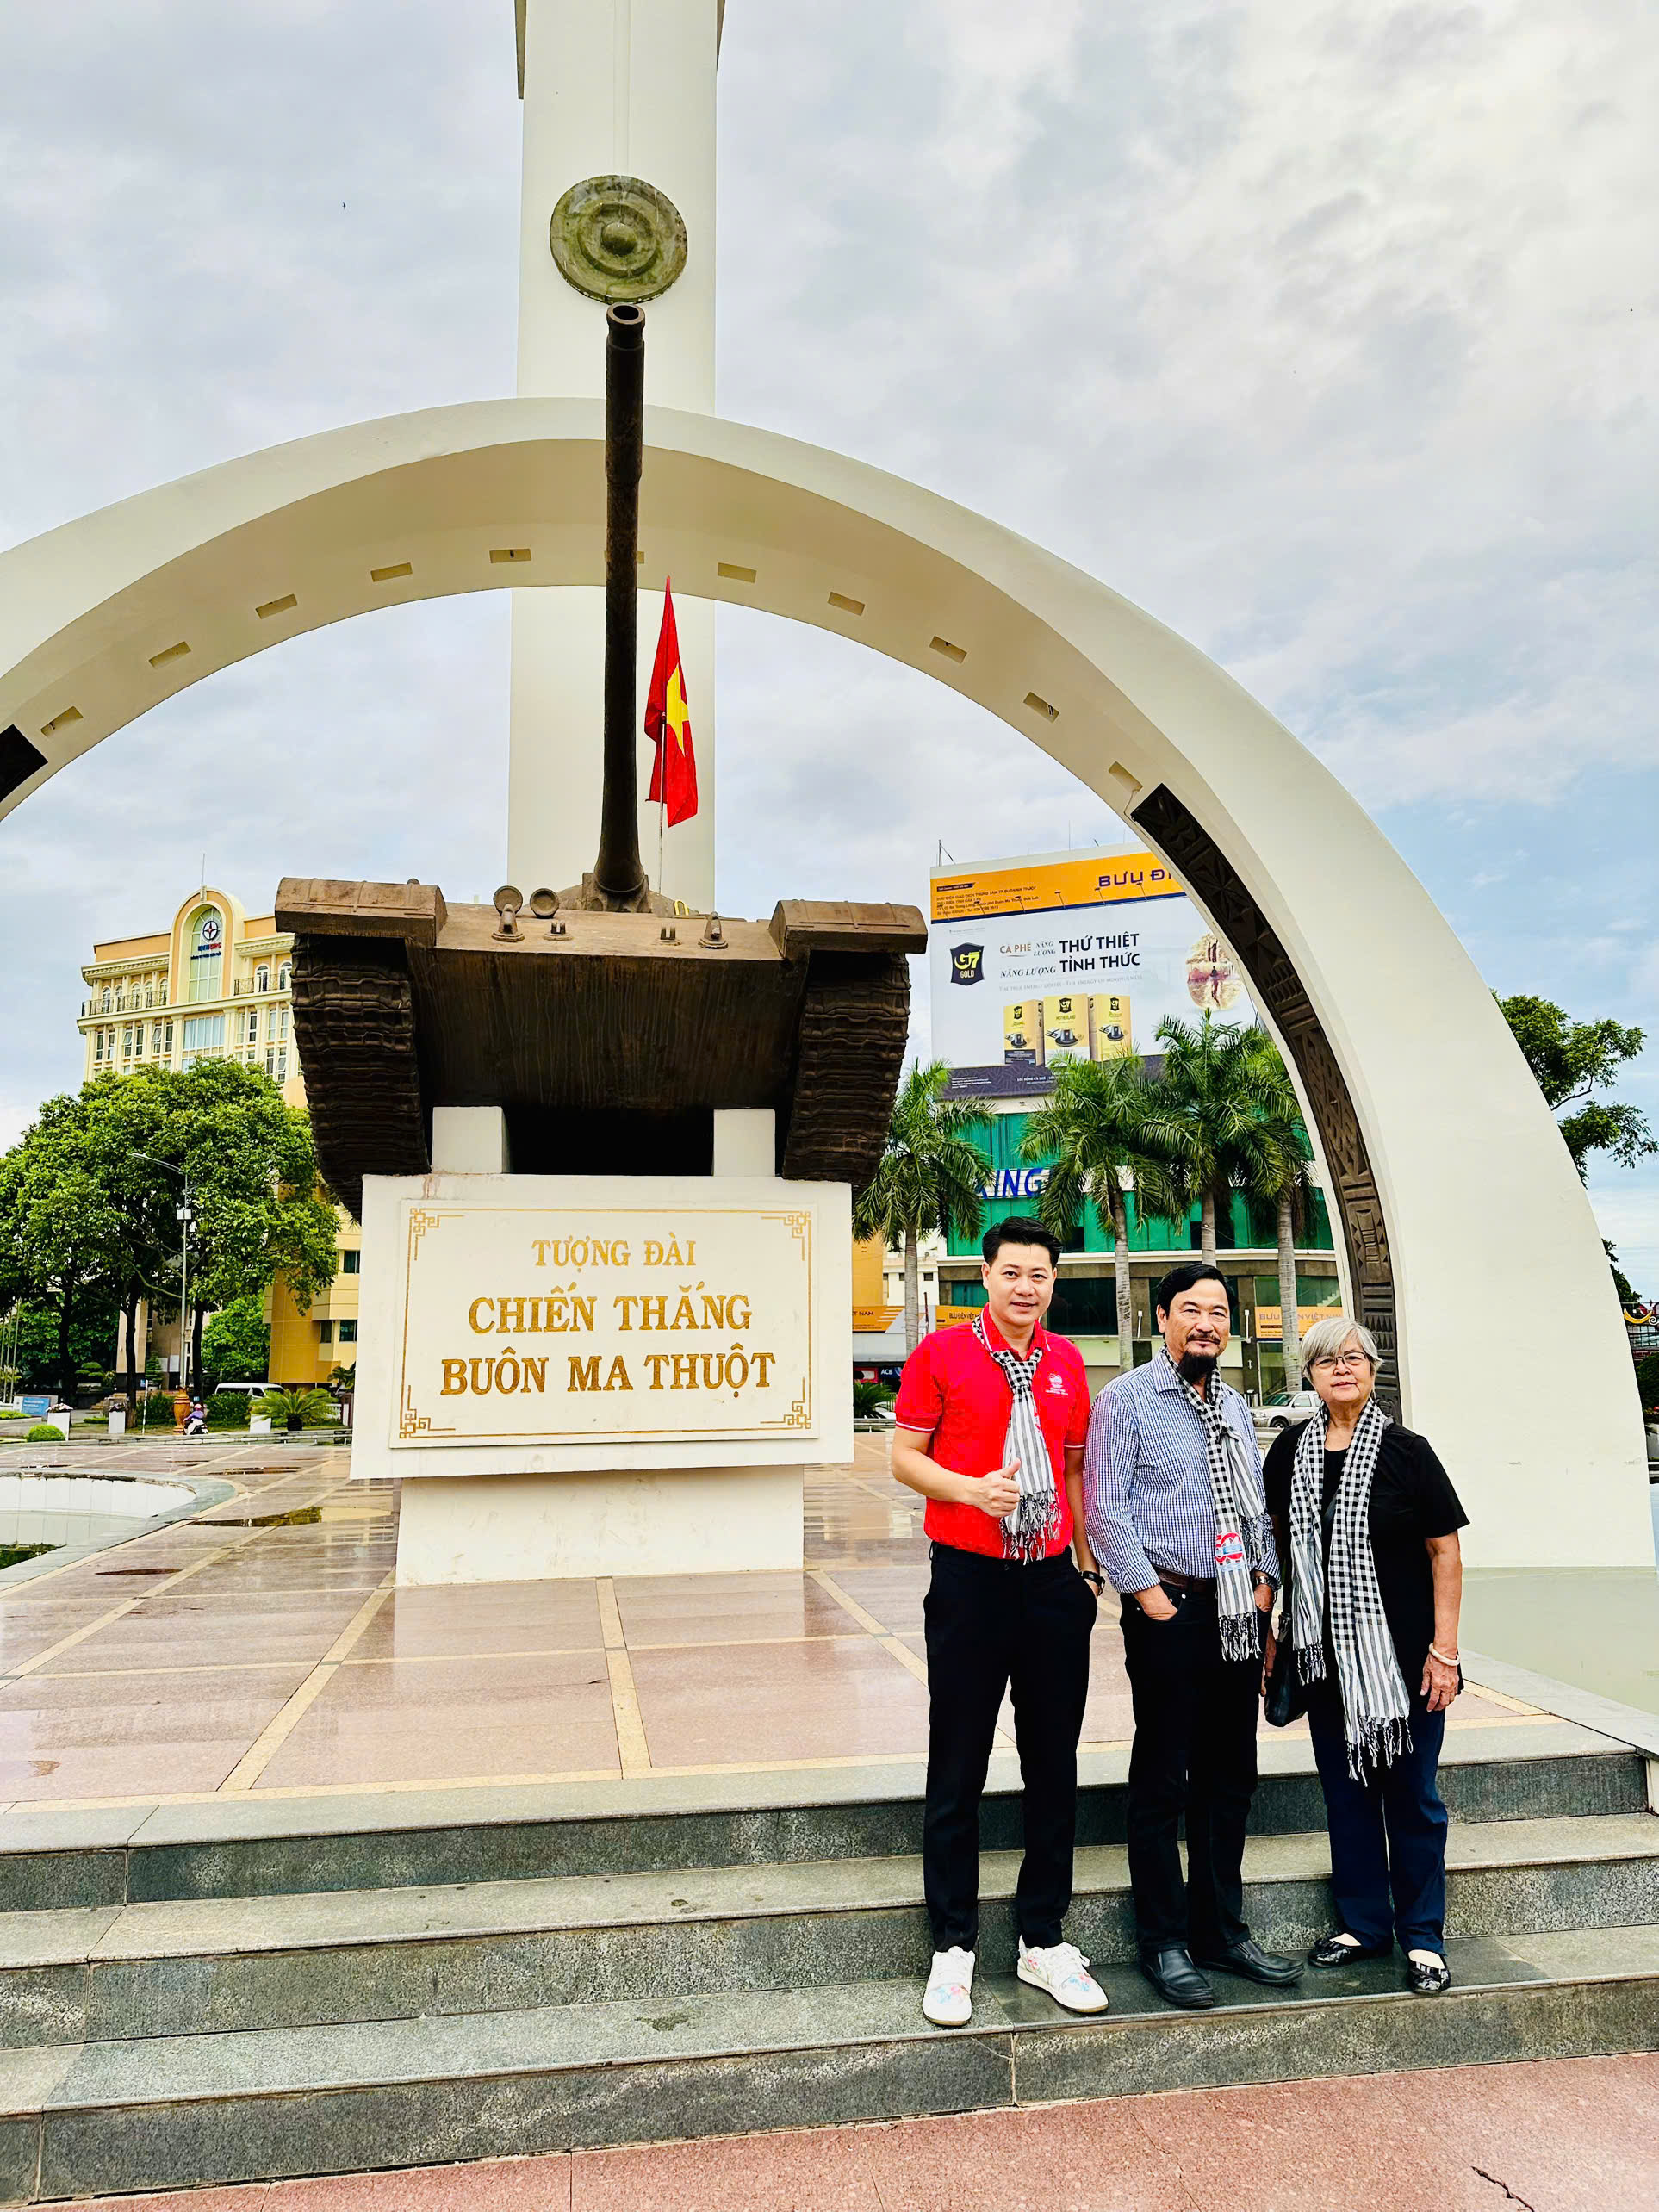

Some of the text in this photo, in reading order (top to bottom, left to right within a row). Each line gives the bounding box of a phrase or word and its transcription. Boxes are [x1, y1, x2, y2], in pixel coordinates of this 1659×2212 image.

[1015, 941, 1032, 953] PHÊ
[1059, 935, 1093, 954] THỨ
[1096, 931, 1140, 950] THIỆT
[960, 970, 975, 979] GOLD
[1000, 951, 1140, 978] NĂNG LƯỢNG TỈNH THỨC
[531, 1232, 696, 1273] TƯỢNG ĐÀI
[468, 1281, 753, 1334] CHIẾN THẮNG
[440, 1342, 776, 1398] BUÔN MA THUỘT
